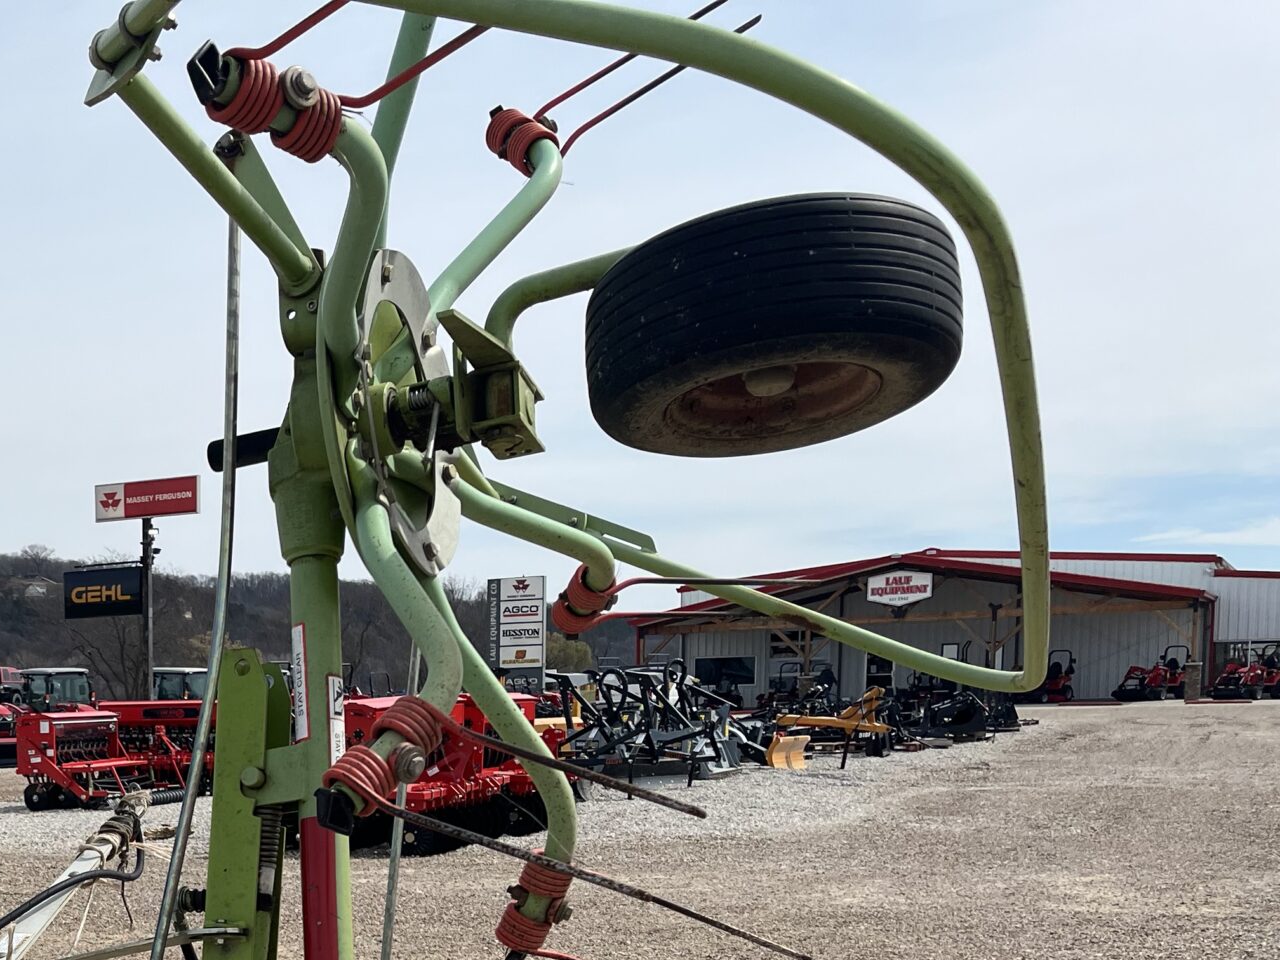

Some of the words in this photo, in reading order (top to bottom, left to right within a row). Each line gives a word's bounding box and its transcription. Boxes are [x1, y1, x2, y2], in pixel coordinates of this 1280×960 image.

[126, 495, 153, 504] MASSEY
[155, 491, 192, 501] FERGUSON
[885, 576, 912, 586] LAUF
[71, 584, 131, 603] GEHL
[870, 584, 929, 597] EQUIPMENT
[502, 605, 539, 614] AGCO
[490, 597, 498, 640] EQUIPMENT
[502, 628, 540, 637] HESSTON
